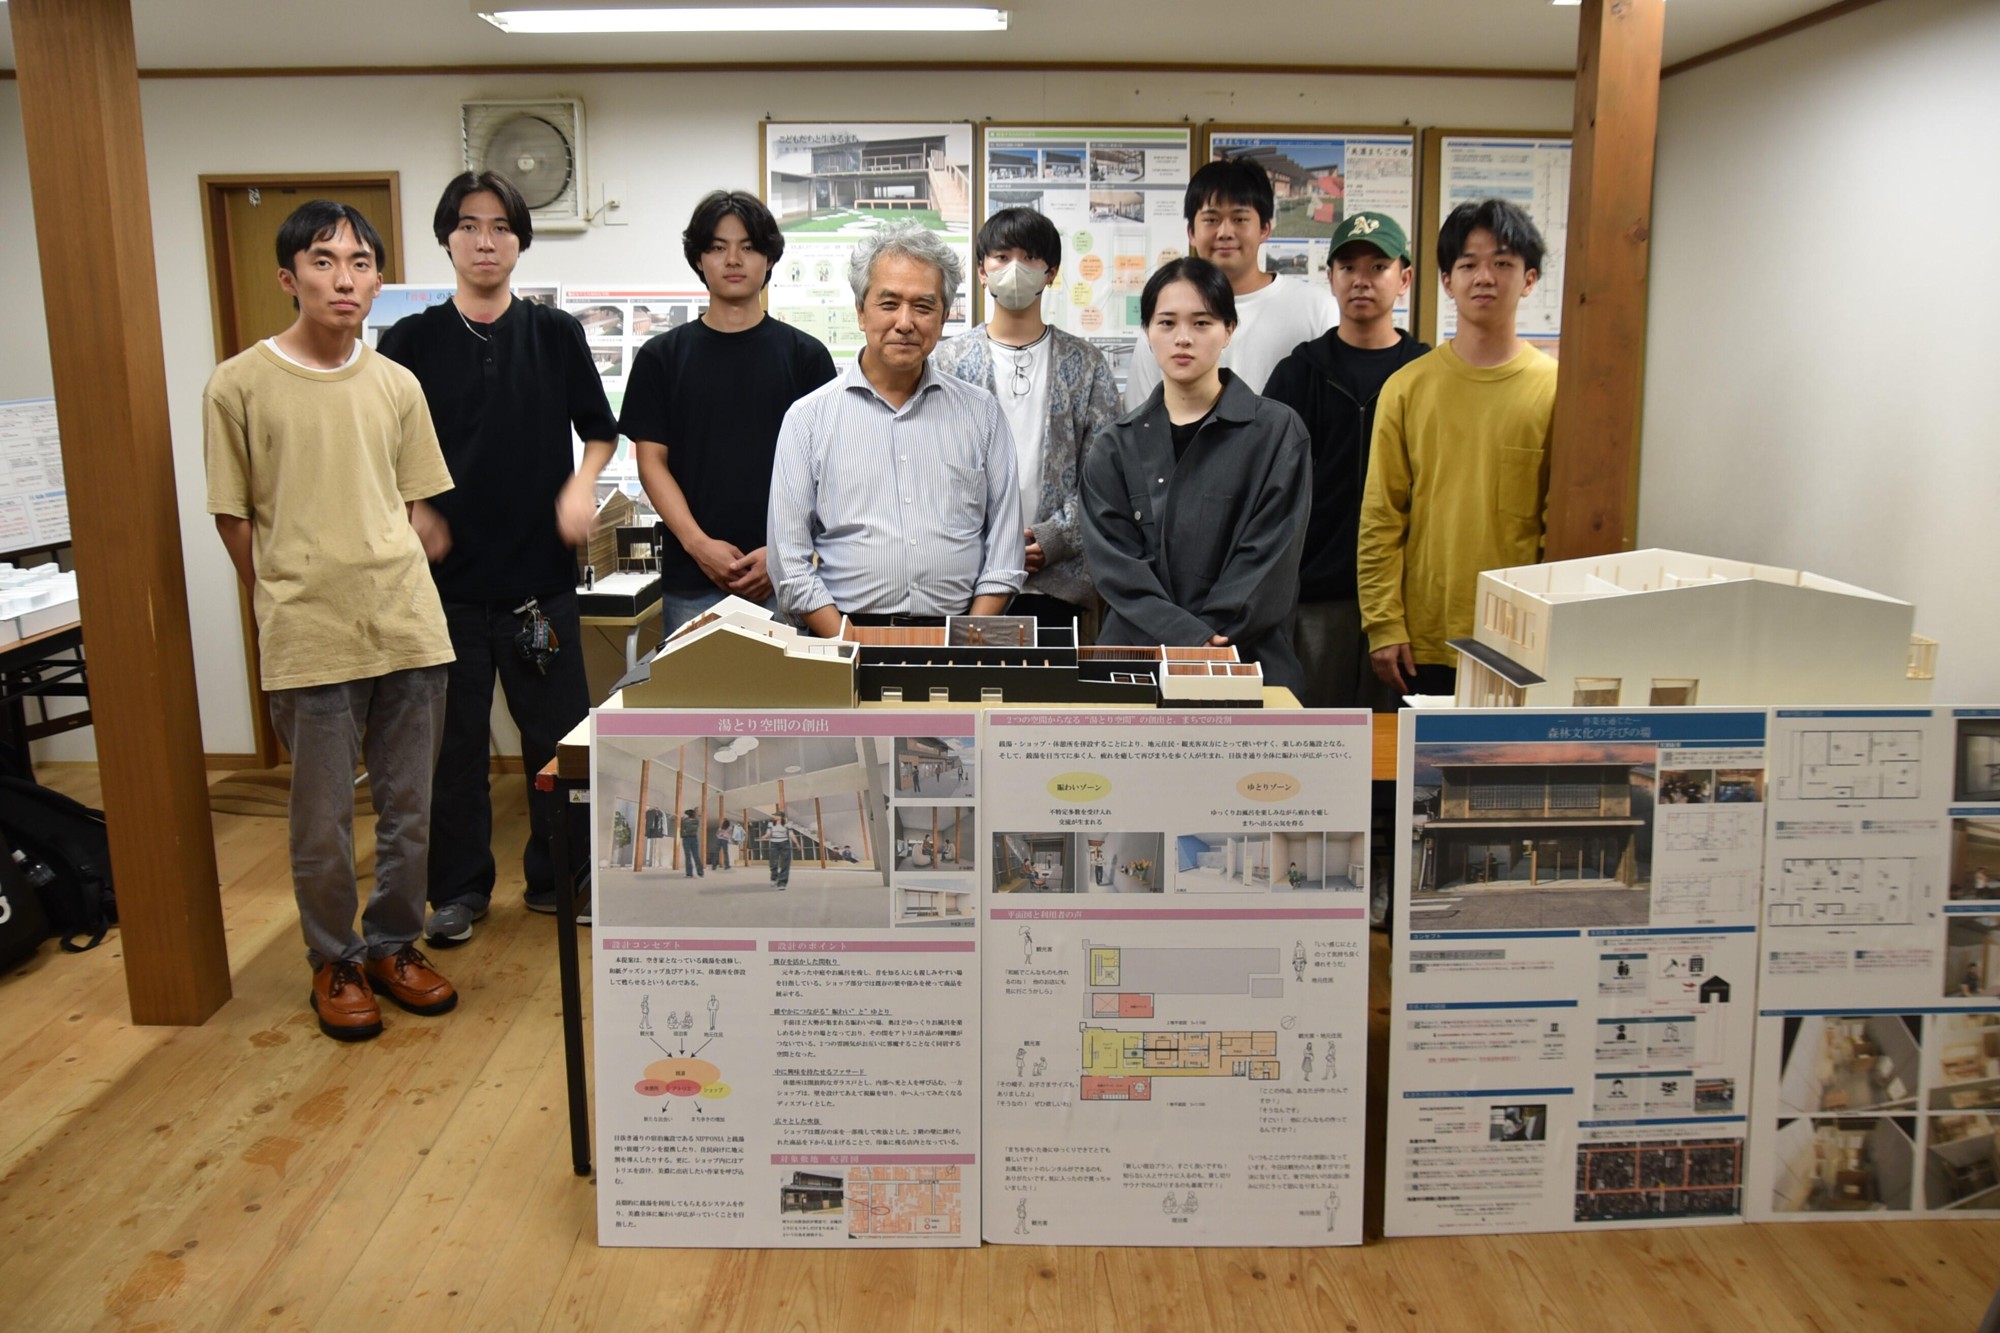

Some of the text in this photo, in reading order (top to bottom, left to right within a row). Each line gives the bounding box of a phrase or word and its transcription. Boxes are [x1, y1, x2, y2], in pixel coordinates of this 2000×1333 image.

[719, 719, 828, 732] 湯とり空間の創出
[1547, 727, 1651, 738] 森林文化の学びの場
[1056, 783, 1100, 791] 賑わいゾーン
[1247, 783, 1291, 791] ゆとりゾーン
[1007, 910, 1082, 919] 平面図と利用者の声
[611, 941, 682, 949] 設計コンセプト
[777, 942, 848, 951] 設計のポイント
